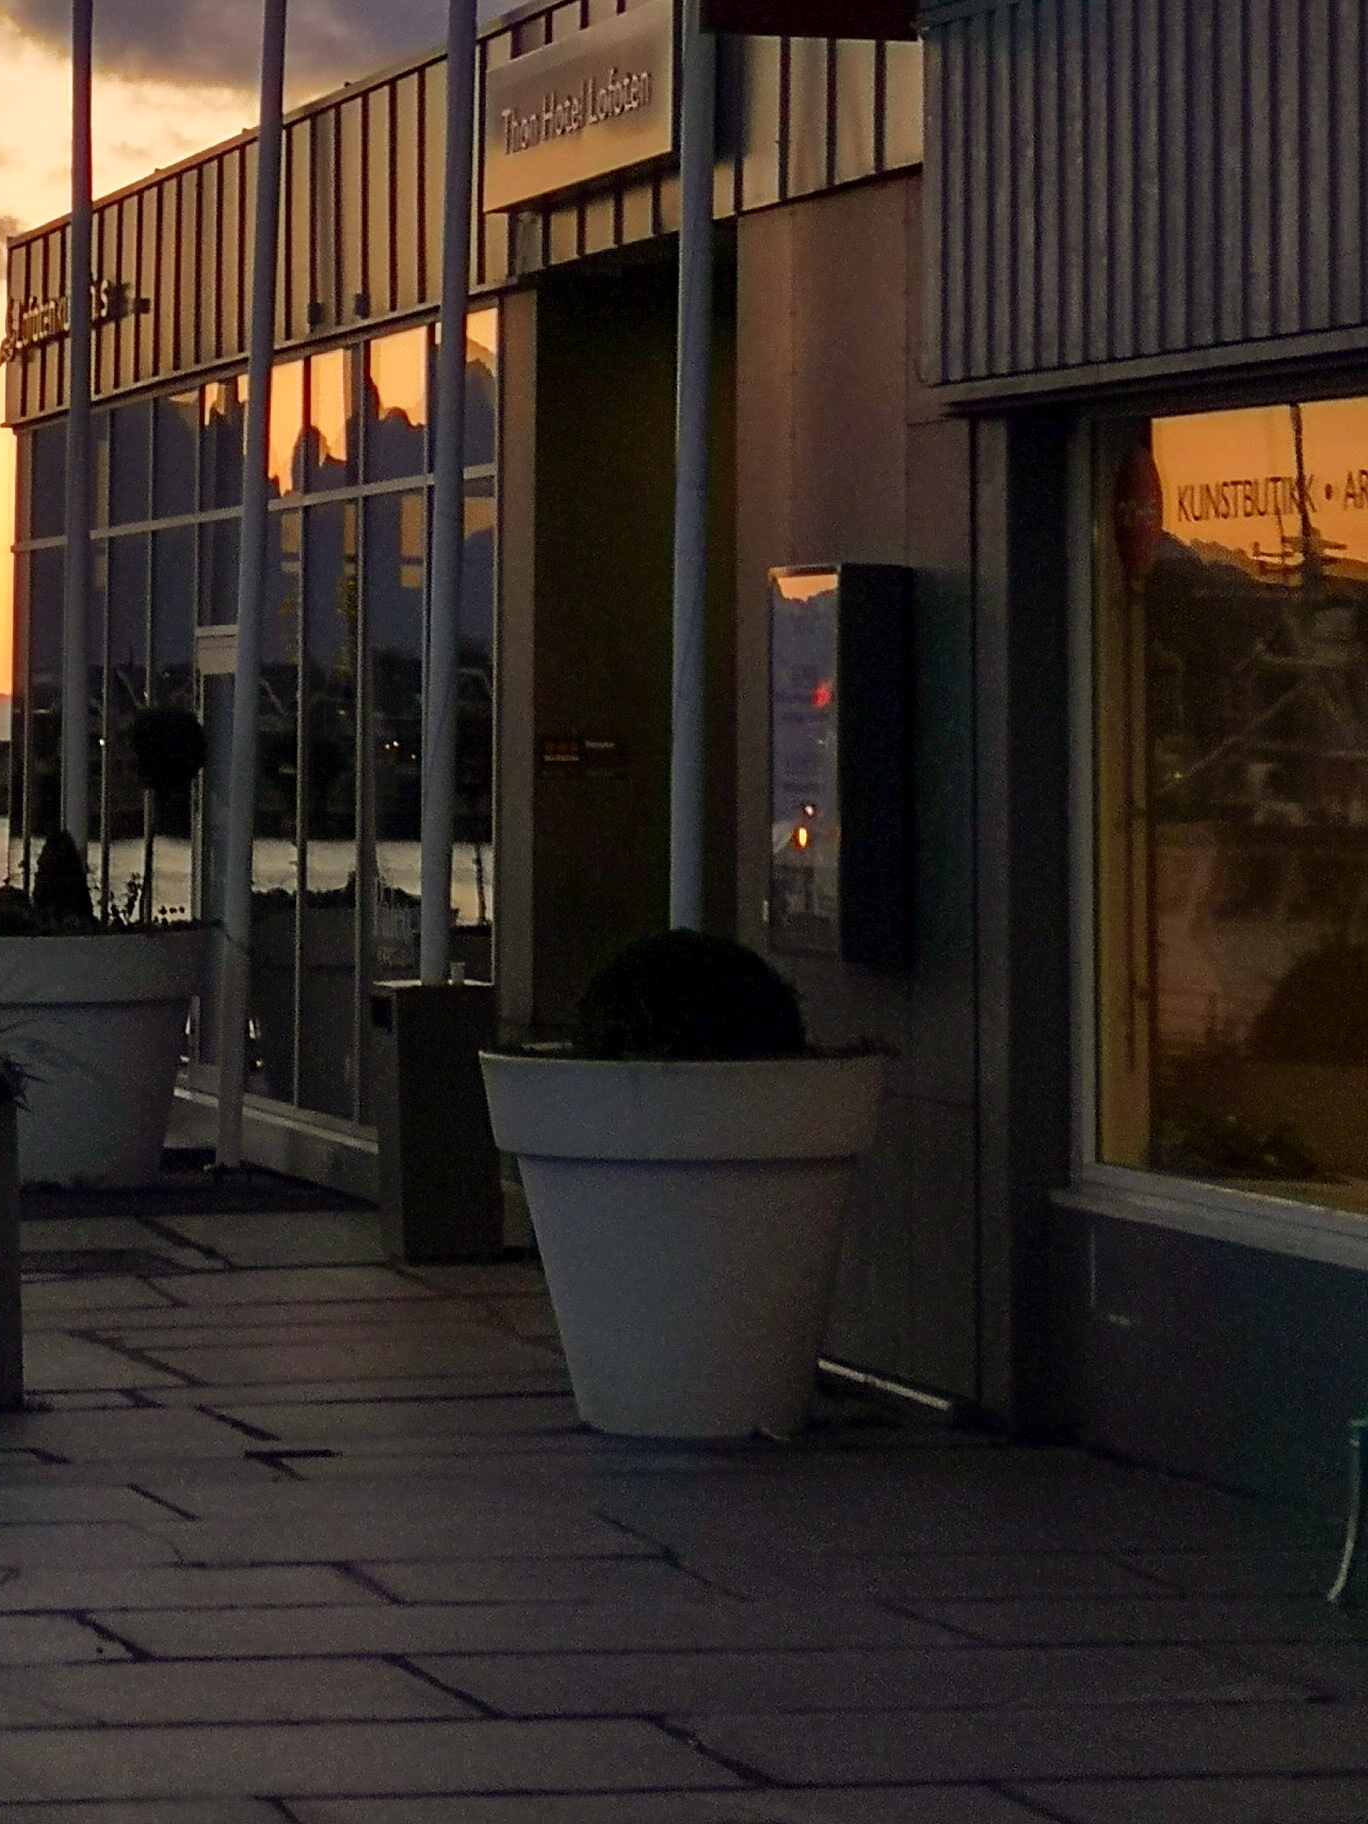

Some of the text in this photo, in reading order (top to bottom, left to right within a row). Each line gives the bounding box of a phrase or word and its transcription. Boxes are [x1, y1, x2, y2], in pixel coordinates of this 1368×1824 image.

[501, 67, 652, 156] Thon Hotel Lofoten
[1178, 474, 1318, 523] KUNSTBUTIKK
